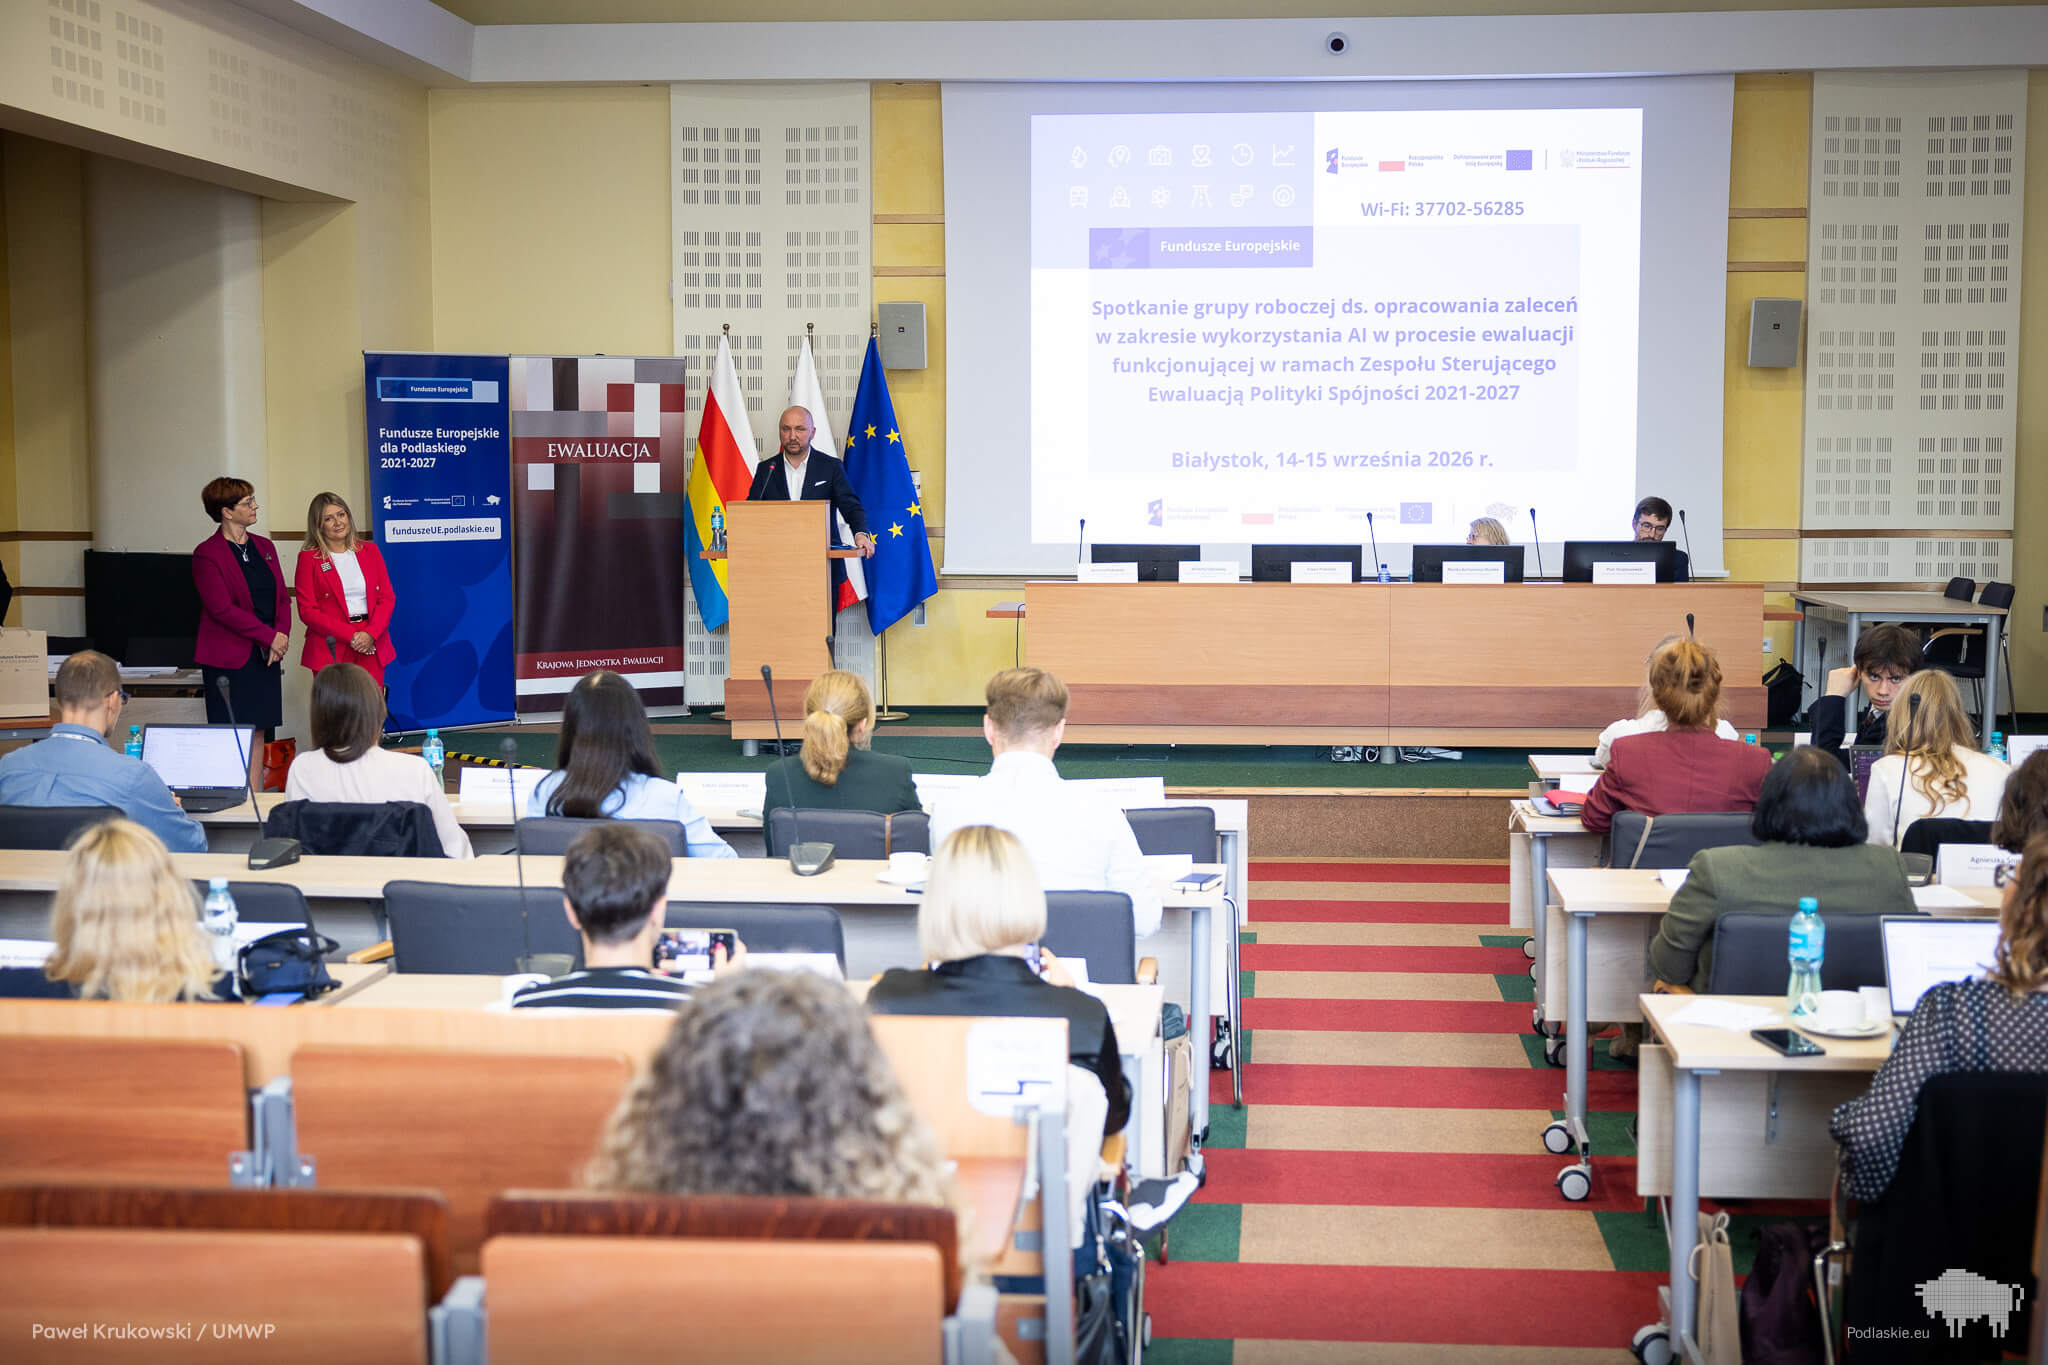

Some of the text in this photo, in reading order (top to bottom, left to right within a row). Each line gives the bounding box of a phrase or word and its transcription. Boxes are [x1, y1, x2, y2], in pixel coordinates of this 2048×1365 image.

[1360, 200, 1525, 217] Wi-Fi: 37702-56285
[1160, 239, 1301, 255] Fundusze Europejskie
[1092, 295, 1578, 321] Spotkanie grupy roboczej ds. opracowania zaleceń
[1095, 325, 1574, 349] w zakresie wykorzystania AI w procesie ewaluacji
[1112, 354, 1557, 378] funkcjonującej w ramach Zespołu Sterującego
[410, 385, 469, 394] Fundusze Europejskie
[1148, 384, 1521, 407] Ewaluacją Polityki Spójności 2021-2027
[379, 427, 500, 441] Fundusze Europejskie
[379, 442, 467, 456] dla Podlaskiego
[547, 442, 651, 461] EWALUACJA
[380, 457, 437, 469] 2021-2027
[1172, 450, 1494, 473] Białystok, 14-15 września 2026 r.
[392, 524, 495, 536] funduszeUE.podlaskie.eu
[536, 655, 664, 670] KRAJOWA JEDNOSTKA EWALUACJI
